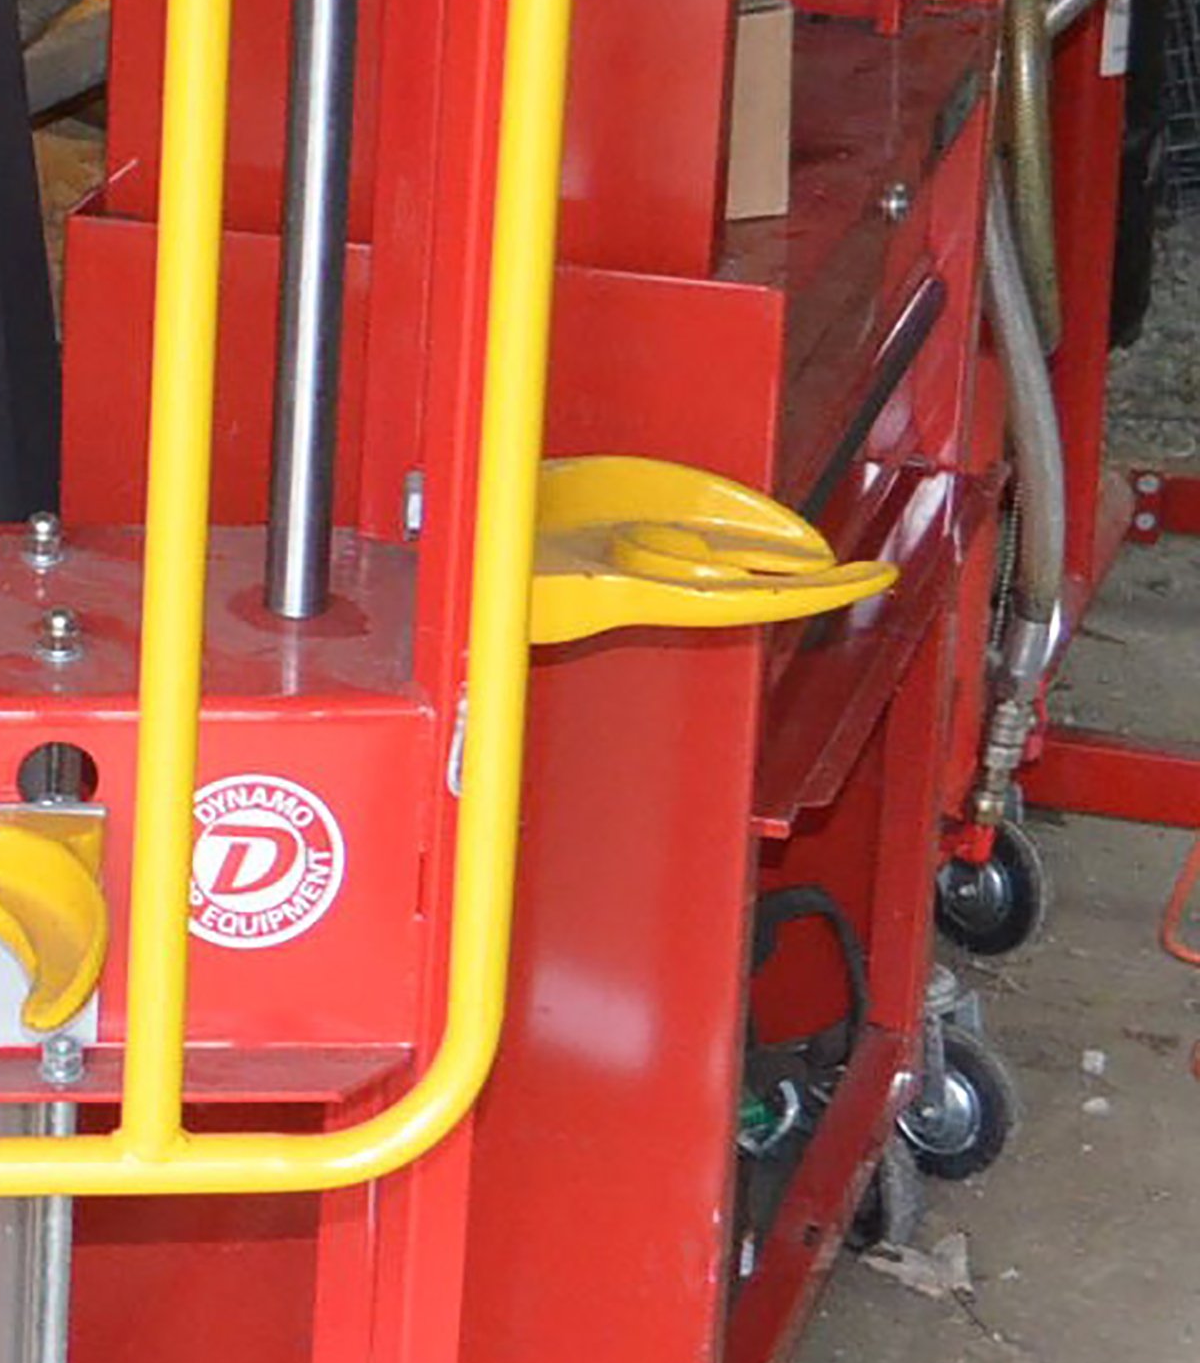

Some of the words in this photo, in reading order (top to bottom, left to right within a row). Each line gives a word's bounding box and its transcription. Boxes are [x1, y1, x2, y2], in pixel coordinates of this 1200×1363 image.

[193, 787, 314, 828] DYNAMO
[201, 849, 332, 936] EQUIPMENT
[206, 824, 299, 895] D
